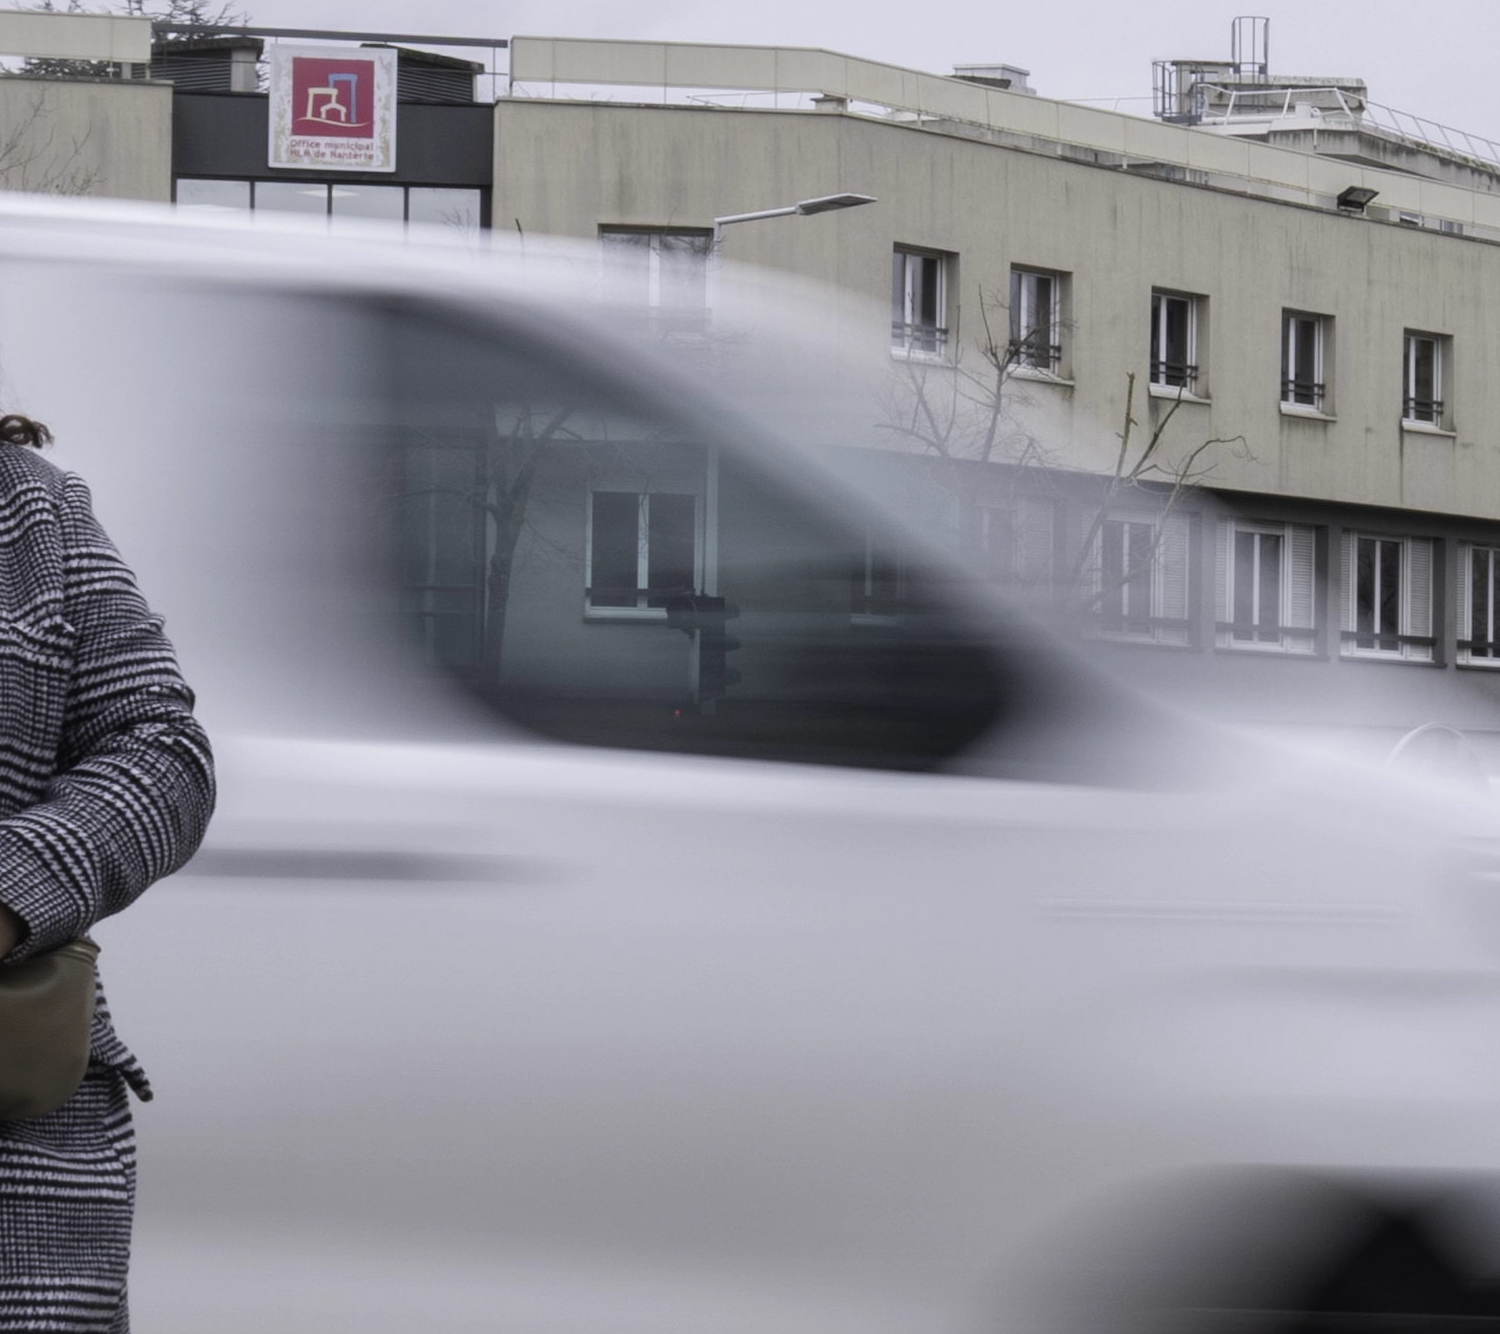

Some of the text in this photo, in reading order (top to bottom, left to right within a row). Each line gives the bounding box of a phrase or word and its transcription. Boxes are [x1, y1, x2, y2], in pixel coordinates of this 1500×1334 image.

[290, 139, 374, 151] Office municipal
[314, 150, 326, 158] de
[330, 150, 374, 160] Nanterre
